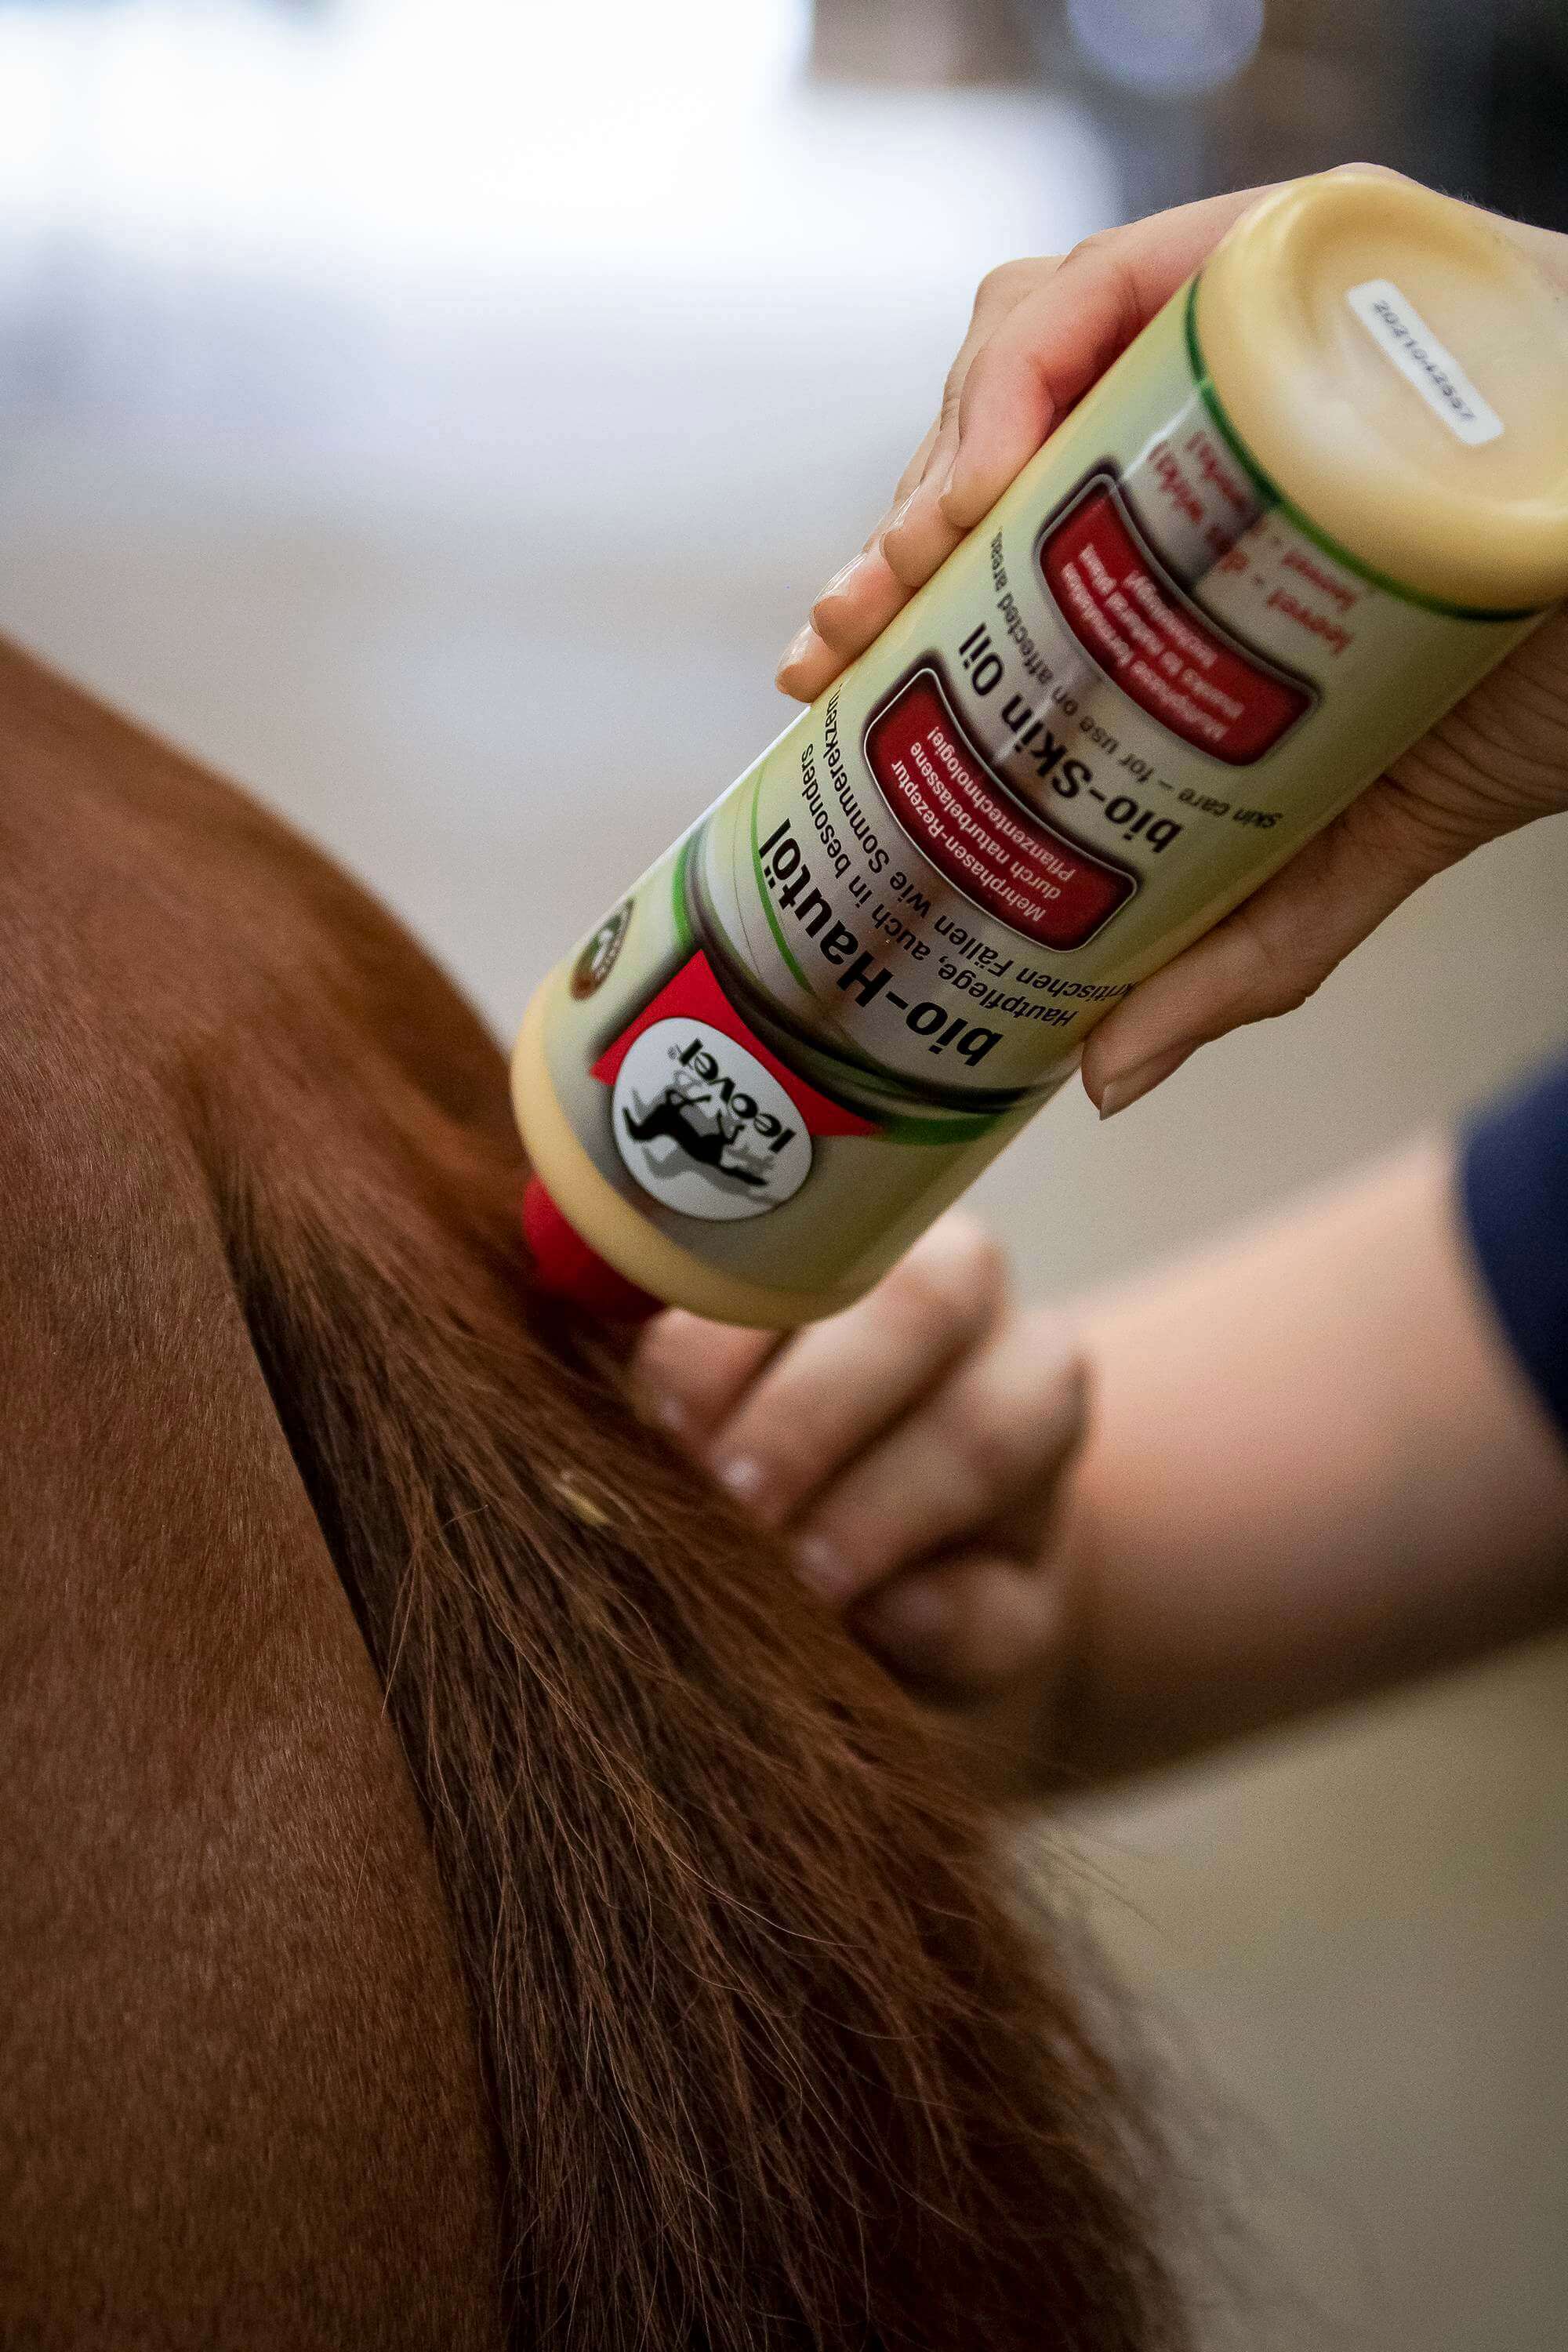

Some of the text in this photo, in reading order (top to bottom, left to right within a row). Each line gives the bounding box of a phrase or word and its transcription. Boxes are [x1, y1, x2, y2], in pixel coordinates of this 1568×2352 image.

[996, 593, 1054, 684] affected
[959, 622, 1185, 853] bio-Skin Oil
[1052, 687, 1079, 717] on
[1080, 716, 1120, 754] use
[909, 742, 1062, 900] durch naturbelassene
[927, 726, 1076, 883] Pflanzentechnologie!
[1119, 753, 1156, 782] for
[800, 743, 1079, 1027] Hautpflege, auch in besonders
[889, 871, 931, 918] wie
[891, 760, 1047, 923] Mehrphasen-Rezeptur
[758, 818, 1004, 1066] bio-Hautöl
[933, 915, 1014, 978] Fällen
